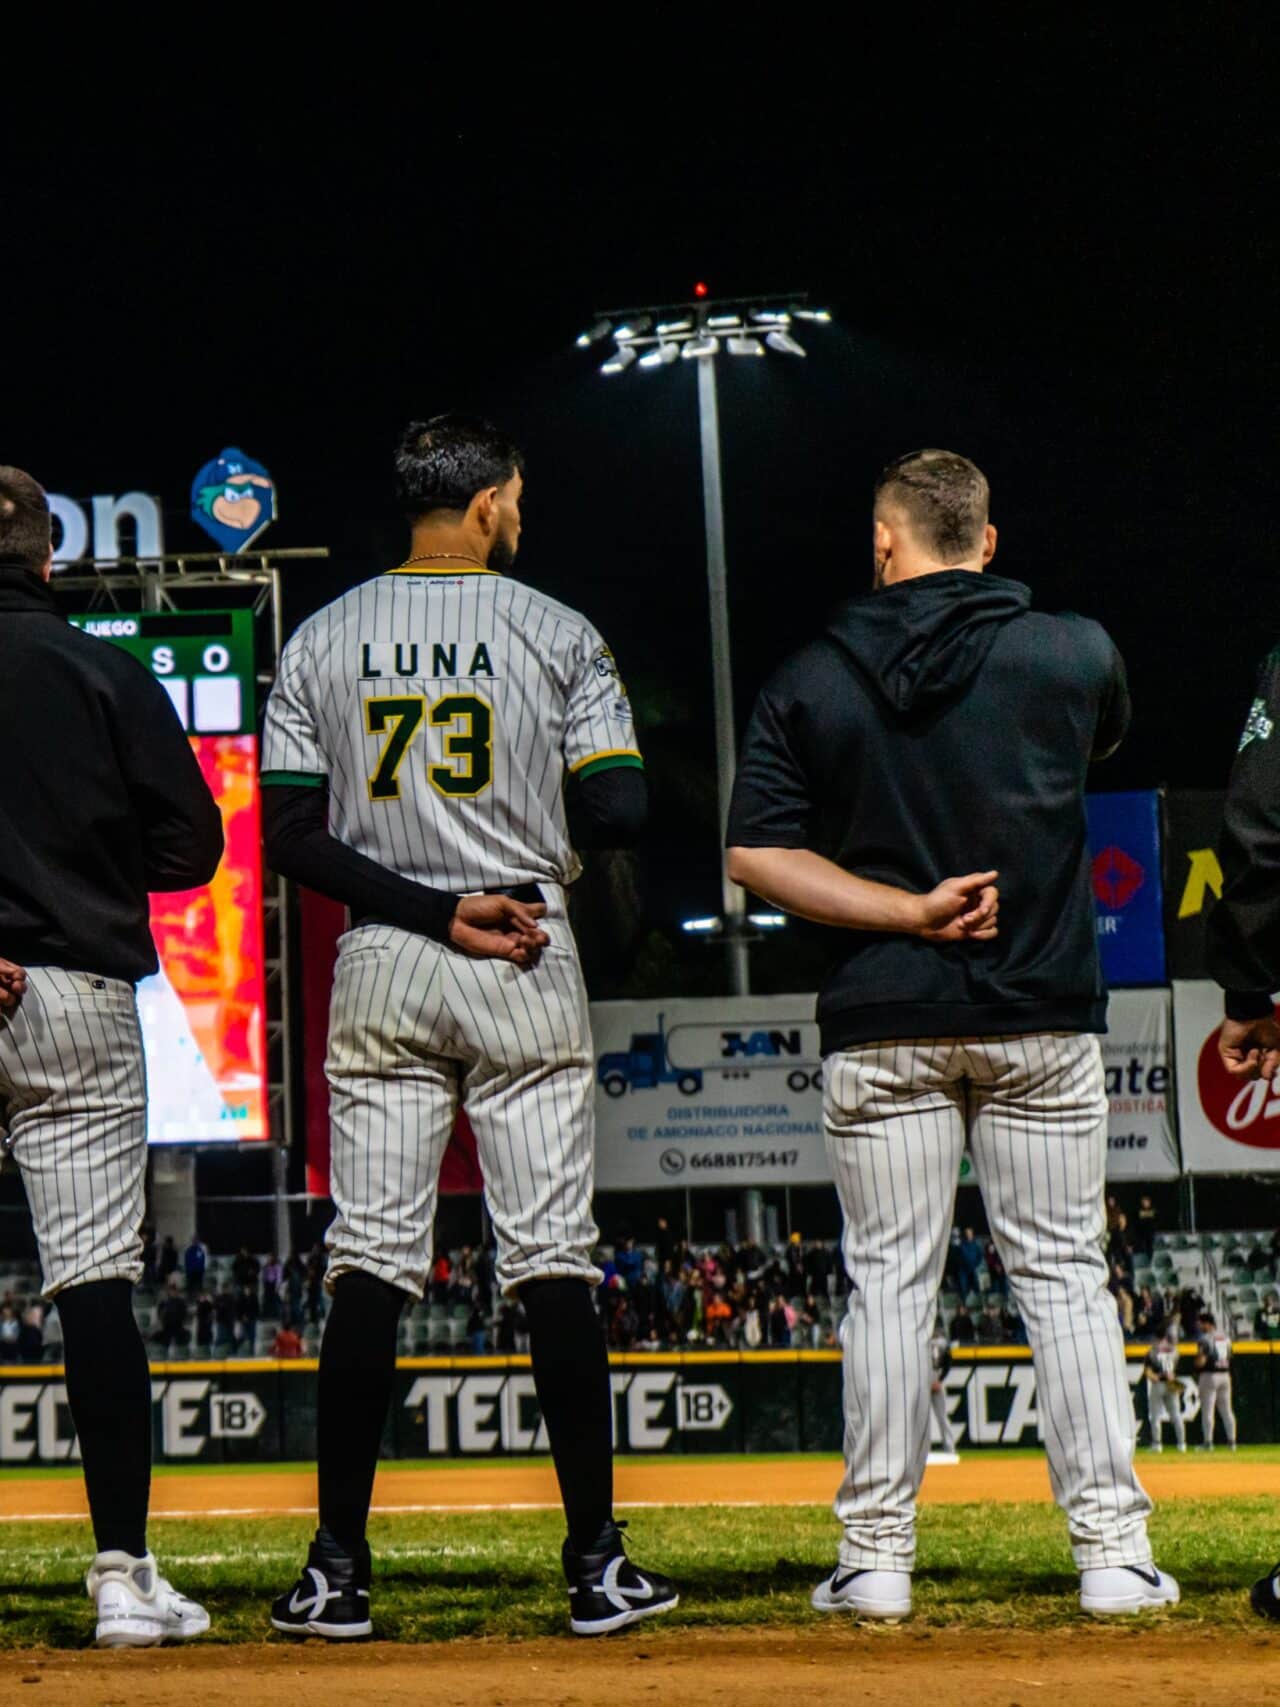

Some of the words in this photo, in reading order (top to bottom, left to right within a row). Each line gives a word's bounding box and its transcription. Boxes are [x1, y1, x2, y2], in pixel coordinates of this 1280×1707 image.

[152, 645, 175, 675] S
[203, 643, 229, 673] O
[362, 642, 494, 678] LUNA
[364, 693, 493, 800] 73
[1105, 1058, 1170, 1095] ate
[667, 1104, 790, 1121] DISTRIBUIDORA
[627, 1126, 649, 1141] DE
[654, 1124, 738, 1140] AMONIACO
[743, 1121, 821, 1137] NACIONAL
[689, 1150, 799, 1169] 6688175447
[215, 1398, 260, 1431] 18+
